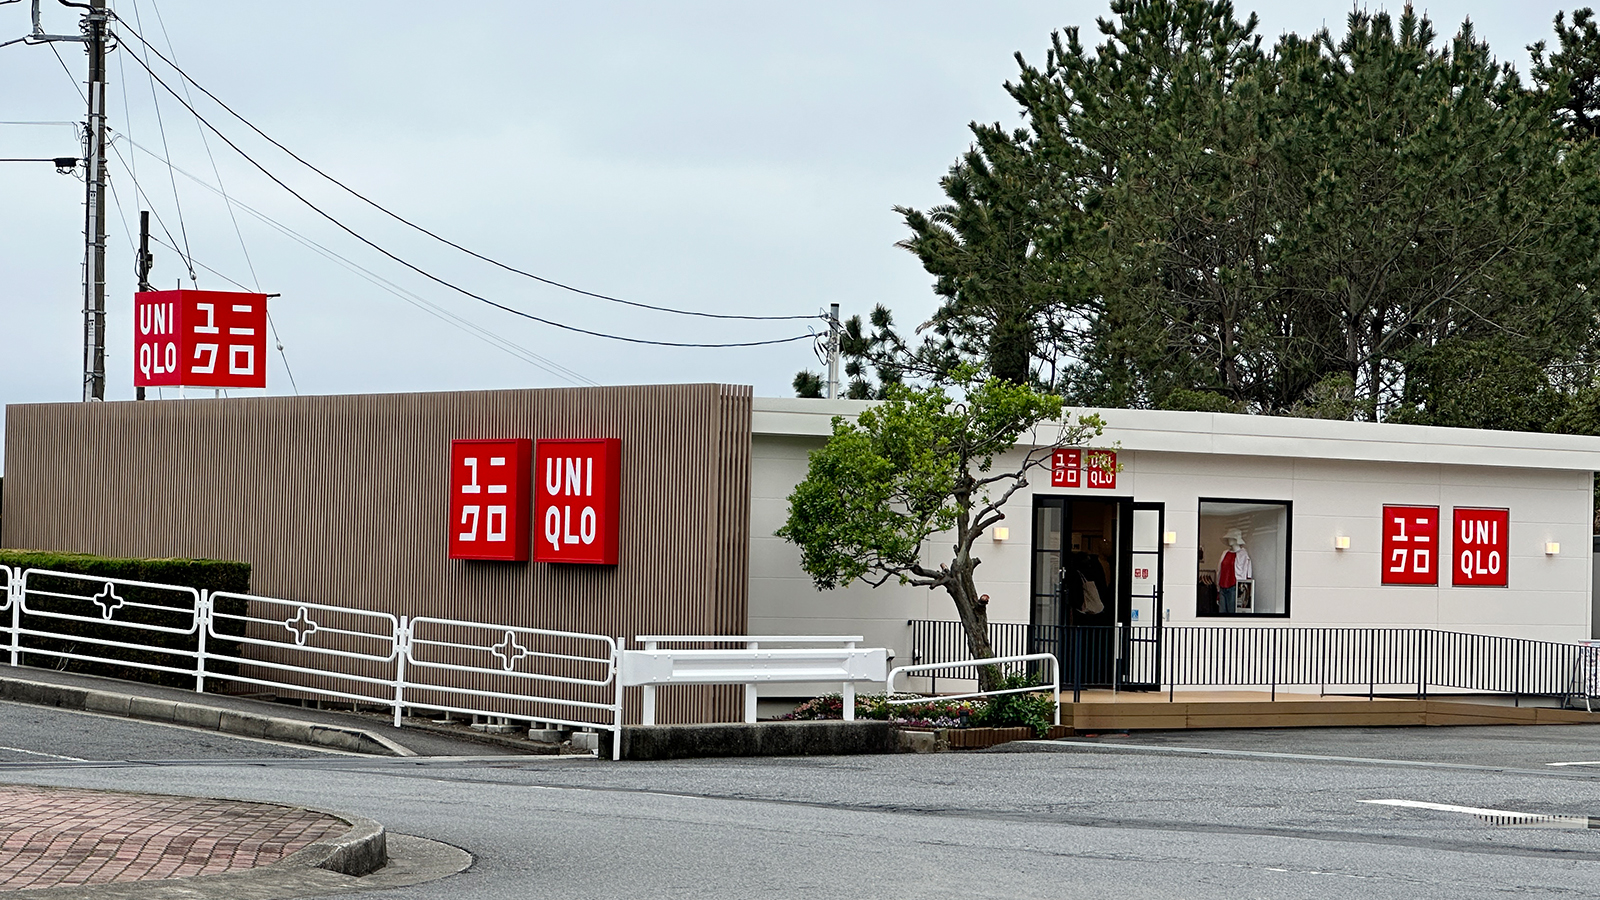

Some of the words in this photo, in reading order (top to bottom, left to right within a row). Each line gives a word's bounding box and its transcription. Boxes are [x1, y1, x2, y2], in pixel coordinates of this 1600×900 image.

[140, 302, 173, 335] UNI
[193, 302, 255, 335] ユニ
[139, 342, 177, 380] QLO
[190, 343, 255, 375] クロ
[461, 457, 507, 494] ユニ
[546, 457, 593, 496] UNI
[1055, 470, 1077, 482] クロ
[1056, 454, 1077, 467] ユニ
[1090, 471, 1113, 485] QLO
[458, 505, 507, 542] クロ
[544, 505, 597, 551] QLO
[1392, 517, 1430, 542] ユニ
[1461, 520, 1497, 545] UNI
[1389, 548, 1430, 573] クロ
[1460, 549, 1501, 579] QLO
